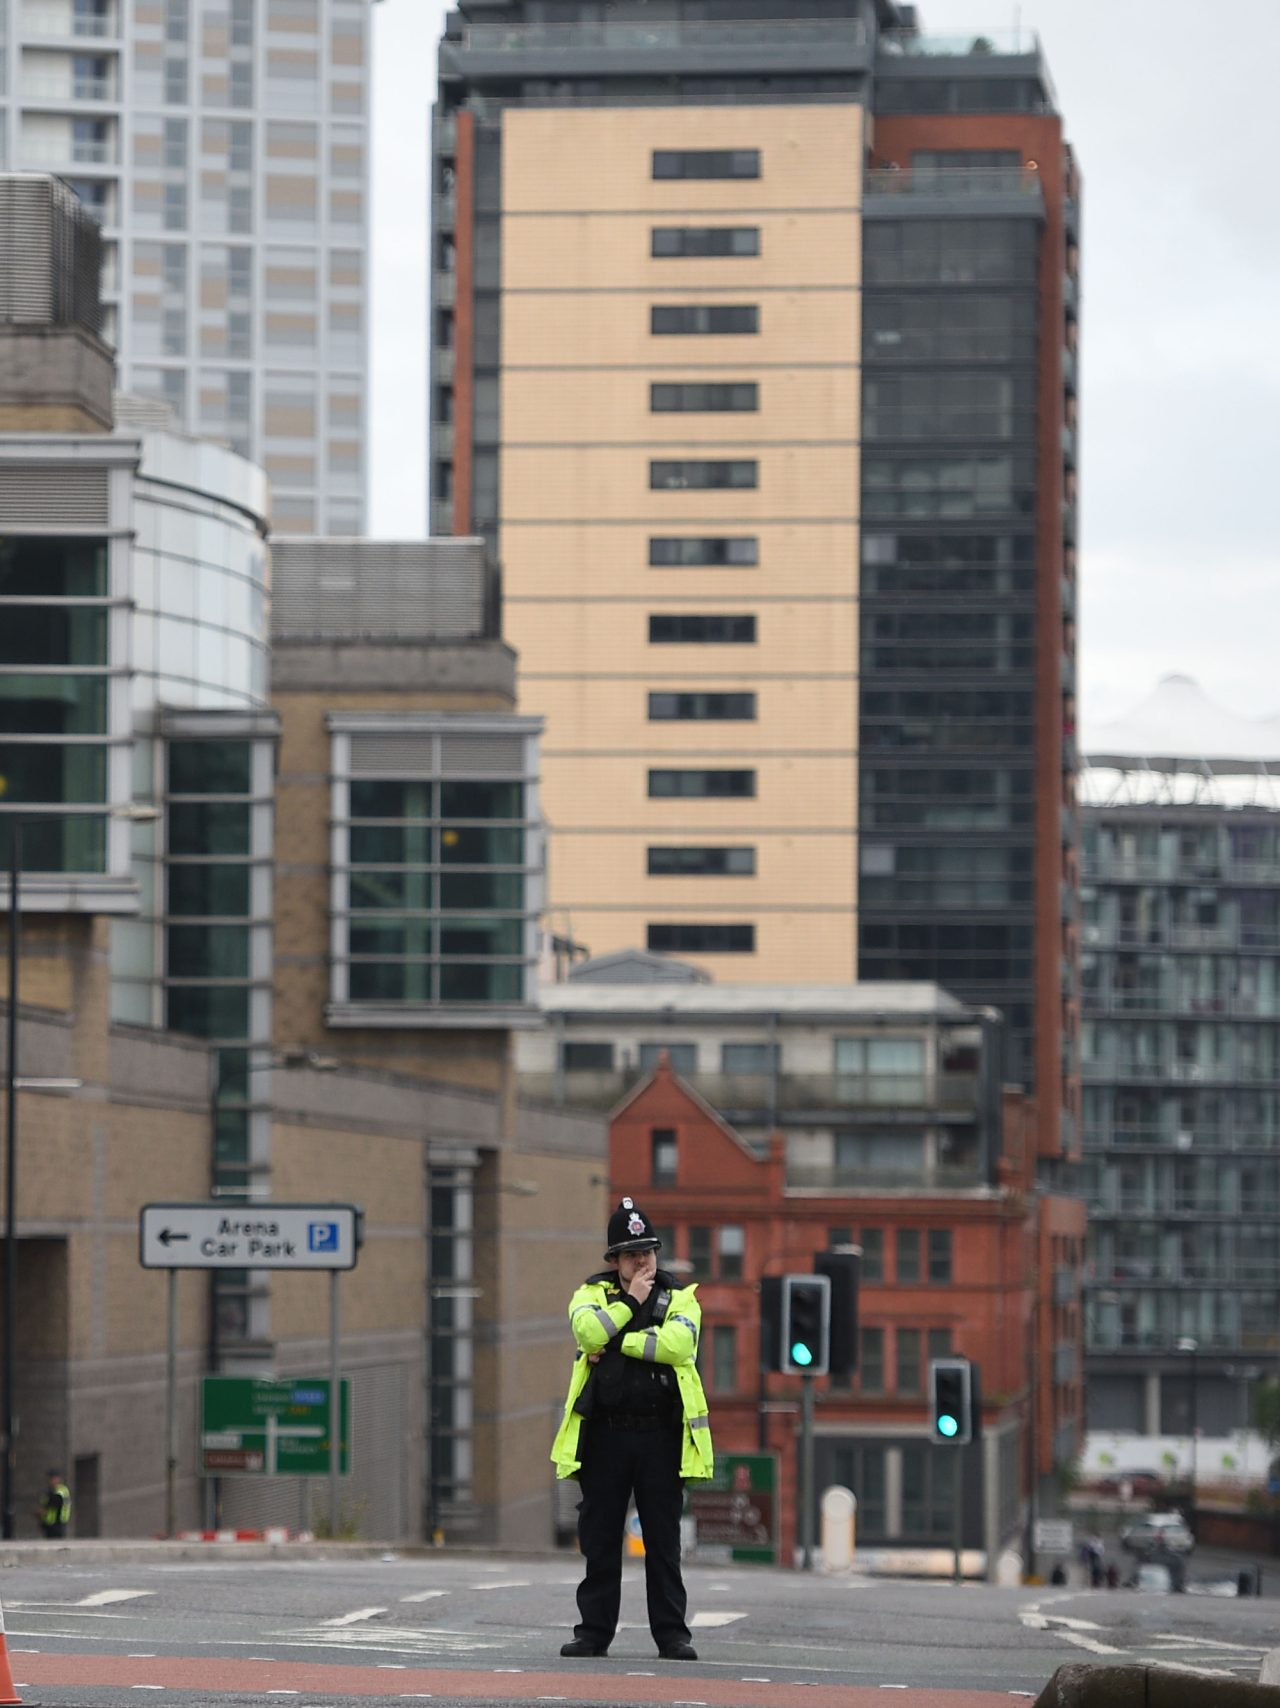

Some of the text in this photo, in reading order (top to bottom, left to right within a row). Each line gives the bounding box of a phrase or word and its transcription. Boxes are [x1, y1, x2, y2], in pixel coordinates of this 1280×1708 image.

[218, 1217, 279, 1236] Arena
[200, 1223, 331, 1258] Car Park P
